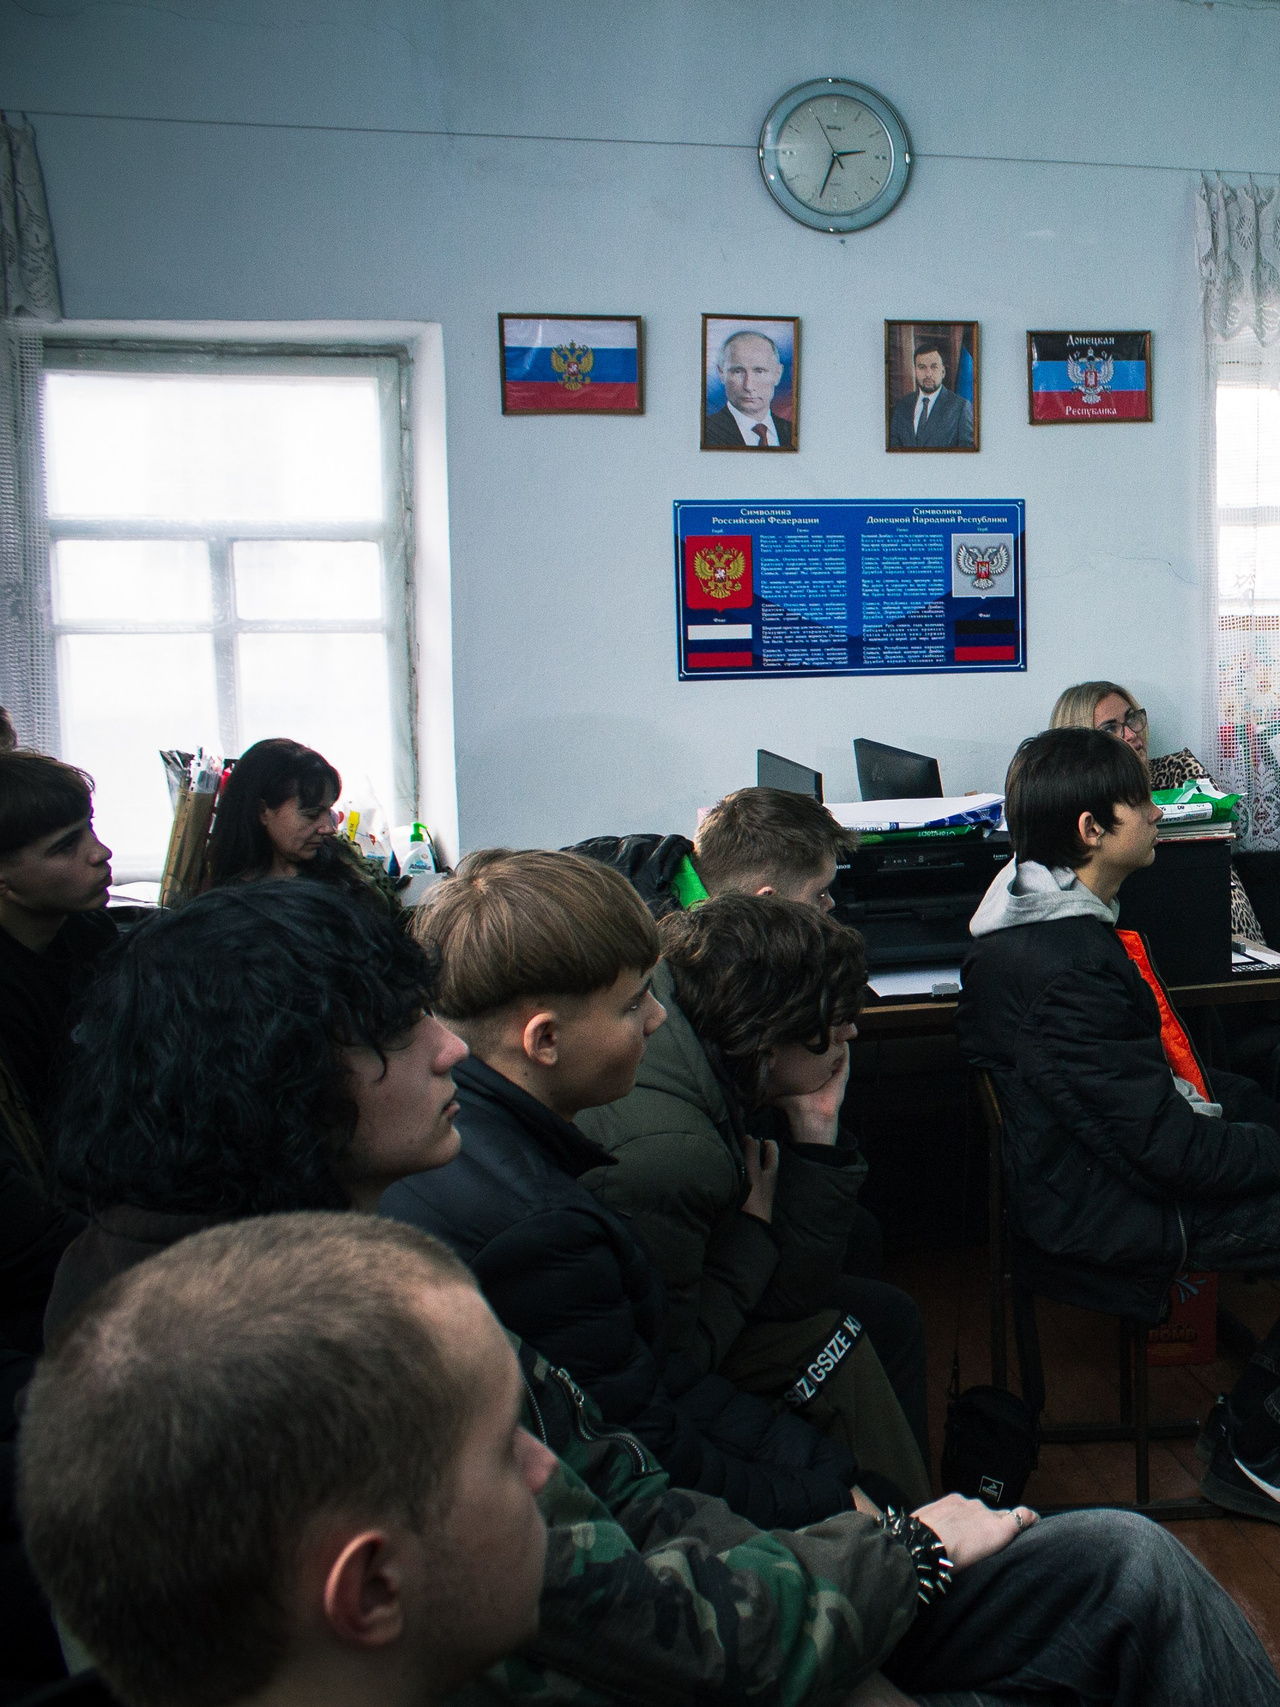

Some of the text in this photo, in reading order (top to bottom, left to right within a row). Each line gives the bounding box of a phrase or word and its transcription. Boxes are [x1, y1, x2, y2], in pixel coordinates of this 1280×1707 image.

[1066, 335, 1115, 346] Донецкая
[1065, 405, 1118, 418] Республика
[740, 508, 791, 516] Символика
[912, 507, 962, 515] Символика
[712, 516, 819, 526] Российской Федерации
[866, 516, 1008, 525] Донецкой Народной Республики
